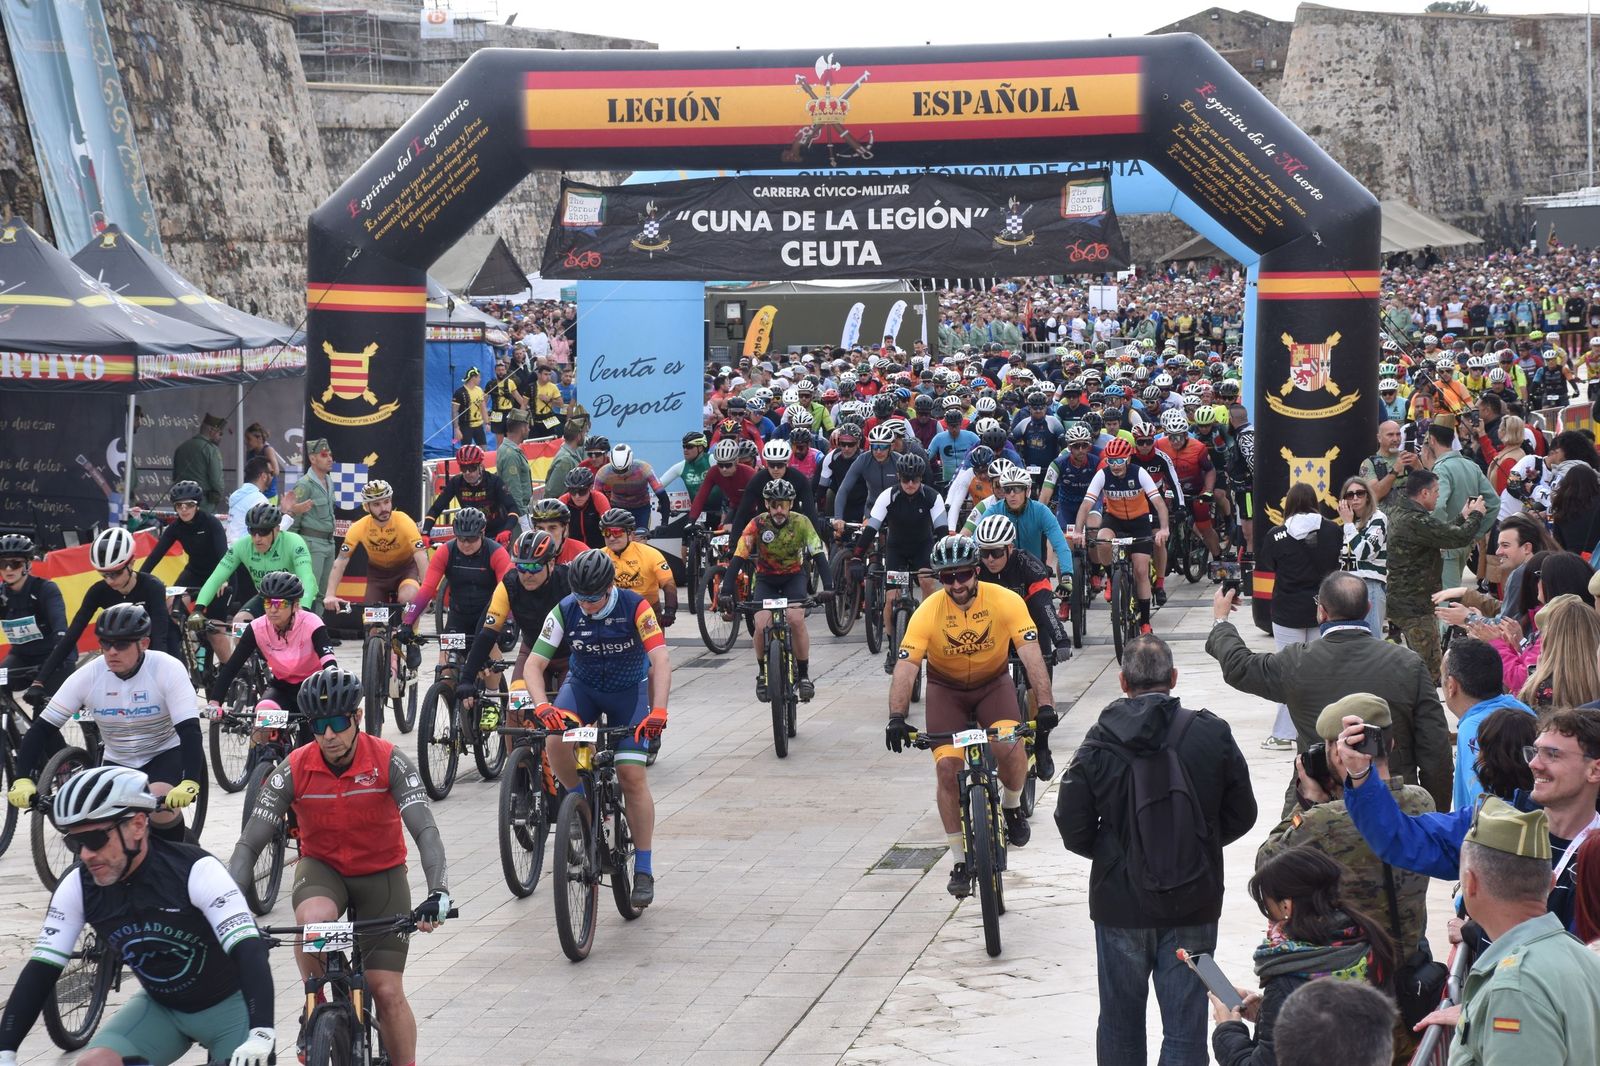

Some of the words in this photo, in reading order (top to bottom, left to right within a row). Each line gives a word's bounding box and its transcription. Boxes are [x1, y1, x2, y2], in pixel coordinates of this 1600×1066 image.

[607, 91, 722, 123] LEGIÓN
[913, 84, 1080, 116] ESPAÑOLA
[1194, 81, 1248, 132] Espíritu
[1247, 132, 1264, 144] de
[1260, 143, 1275, 156] la
[1274, 152, 1323, 200] Muerte
[346, 171, 396, 218] Espíritu
[397, 148, 411, 171] del
[410, 96, 470, 156] Legionario
[435, 153, 443, 163] de
[415, 189, 422, 199] de
[753, 186, 810, 198] CARRERA
[814, 183, 910, 198] CÍVICO-MILITAR
[782, 210, 816, 231] DE
[825, 209, 858, 230] LA
[781, 240, 882, 267] CEUTA
[589, 354, 657, 382] Ceuta
[663, 360, 686, 375] es
[592, 391, 686, 428] Deporte
[1273, 530, 1288, 542] HH
[943, 639, 994, 656] TITANES
[93, 704, 161, 716] HARMAN
